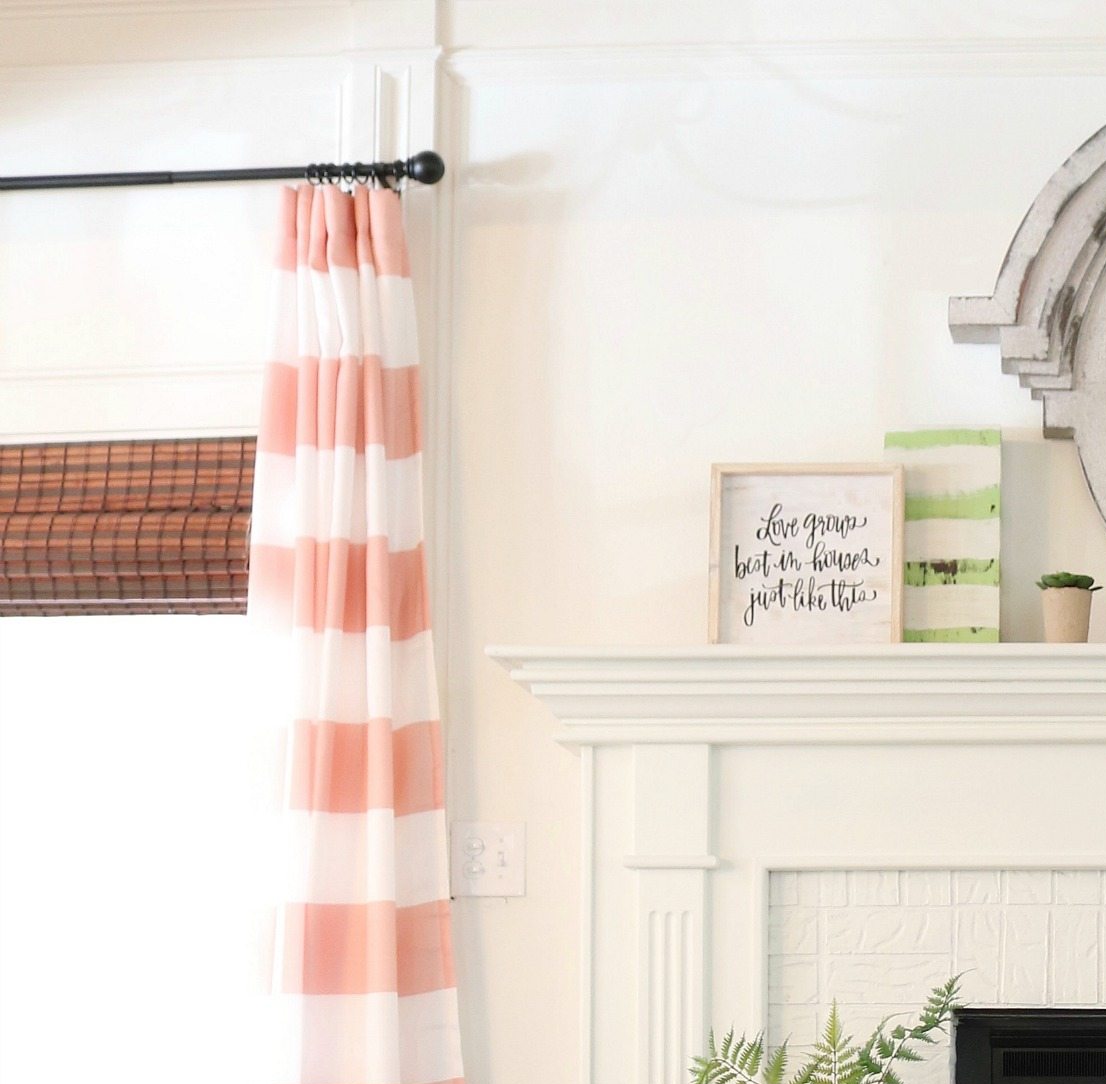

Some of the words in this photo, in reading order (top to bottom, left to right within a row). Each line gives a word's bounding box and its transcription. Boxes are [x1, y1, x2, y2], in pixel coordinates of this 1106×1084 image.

[756, 503, 799, 546] Love
[803, 513, 867, 549] grows
[735, 544, 772, 579] best
[774, 549, 802, 571] in
[805, 542, 880, 572] houses
[744, 578, 793, 627] just
[788, 576, 827, 611] like
[818, 579, 877, 612] this
